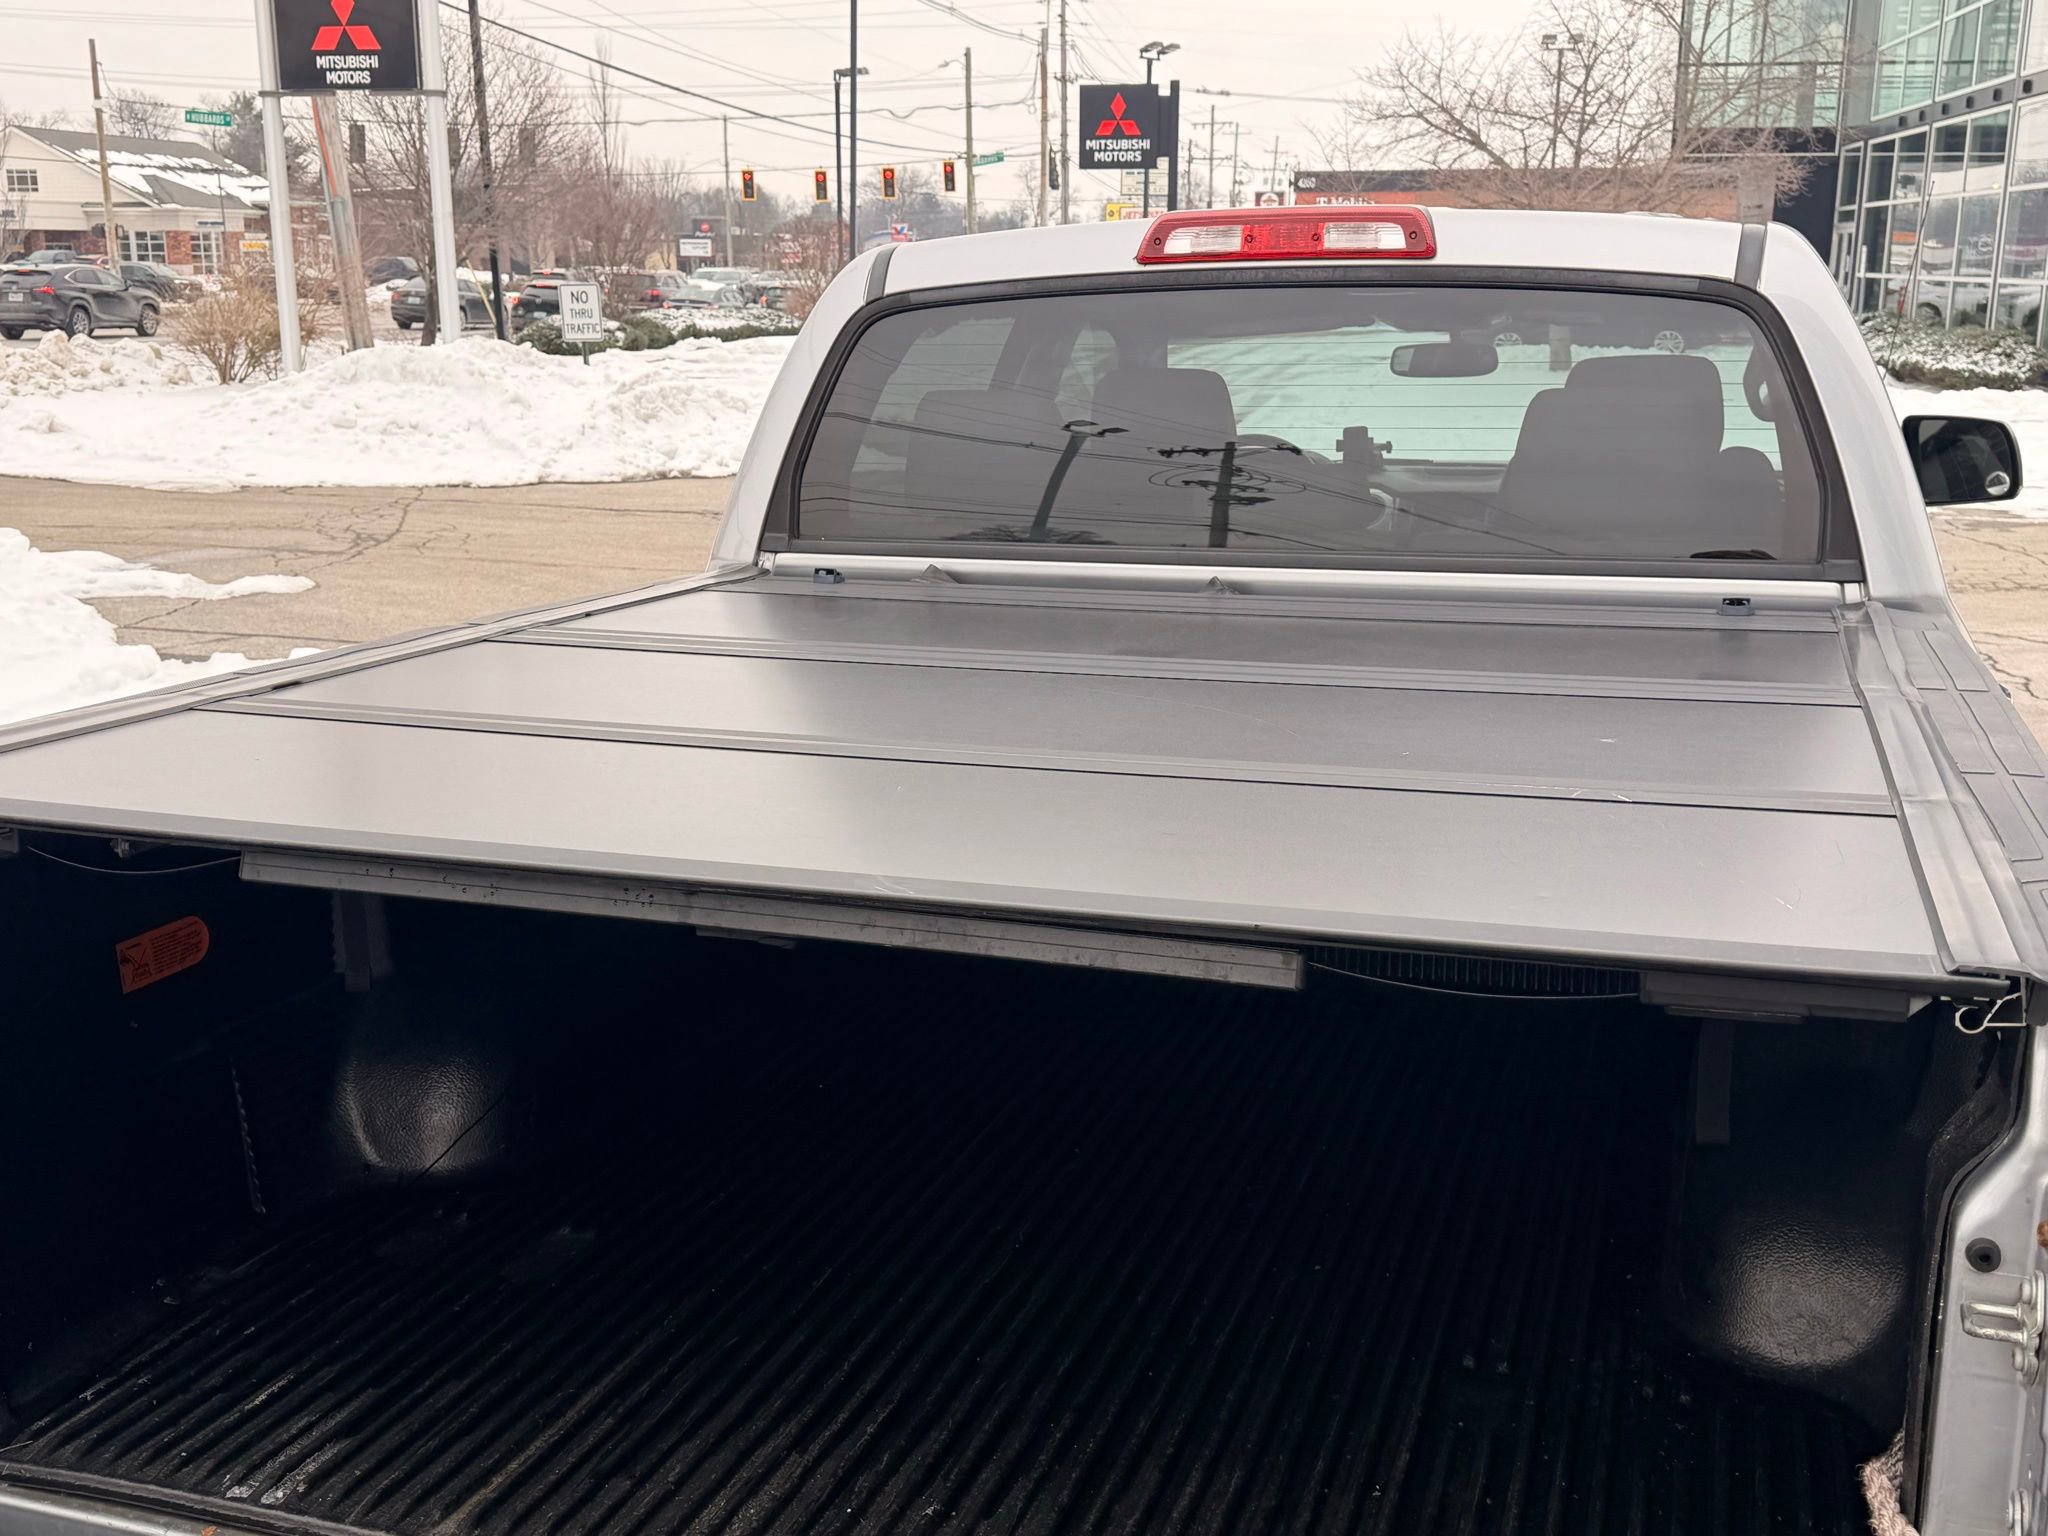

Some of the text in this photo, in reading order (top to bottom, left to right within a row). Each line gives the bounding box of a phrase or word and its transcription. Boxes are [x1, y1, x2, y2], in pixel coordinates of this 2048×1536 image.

[316, 55, 379, 69] MITSUBISHI
[326, 70, 371, 84] MOTORS
[1086, 139, 1151, 150] MITSUBISHI
[1094, 151, 1142, 162] MOTORS
[571, 290, 589, 304] NO
[570, 308, 593, 320] THRU
[566, 323, 600, 334] TRAFFIC
